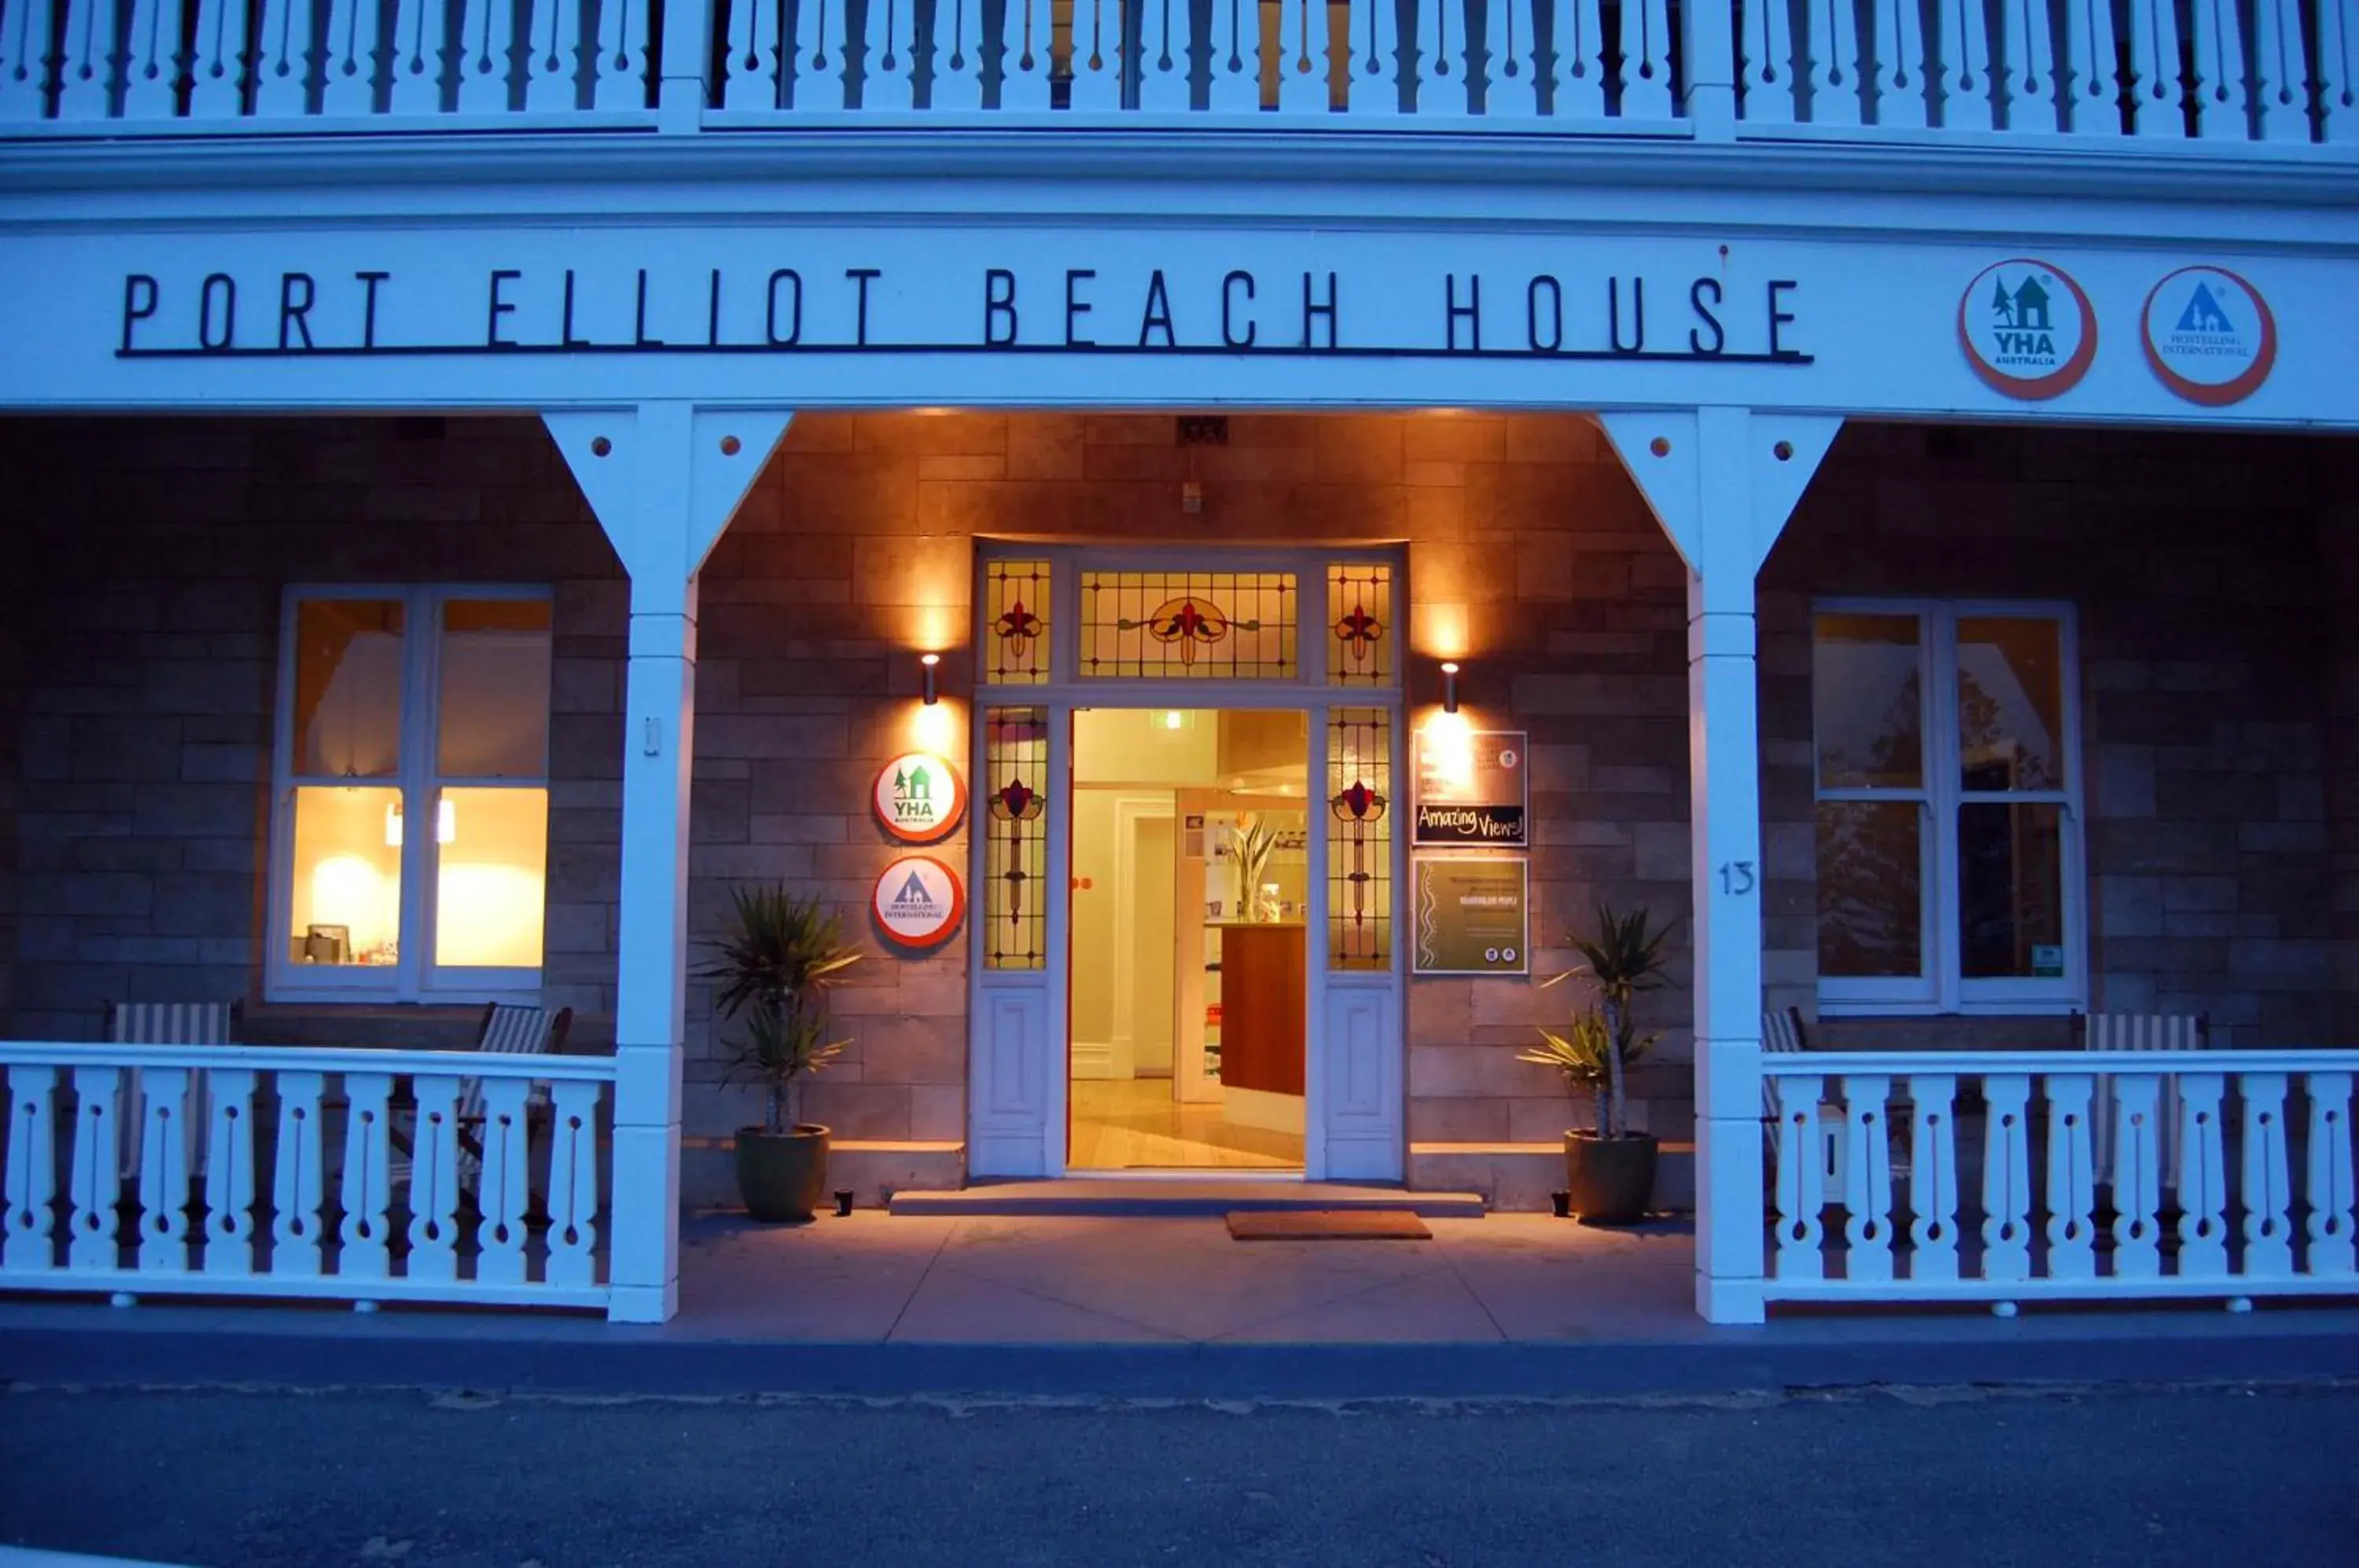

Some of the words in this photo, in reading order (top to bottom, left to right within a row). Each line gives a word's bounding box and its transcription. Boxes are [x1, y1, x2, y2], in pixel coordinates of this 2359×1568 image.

[123, 271, 390, 351] PORT
[487, 268, 881, 346] ELLIOT
[983, 268, 1337, 348] BEACH
[1445, 274, 1801, 357] HOUSE
[1993, 332, 2055, 355] YHA
[2162, 344, 2250, 357] INTERNATIONAL
[1996, 356, 2056, 366] AUSTRALIA
[894, 802, 933, 815] YHA
[1418, 805, 1478, 834] Amazing
[1717, 860, 1754, 896] 13
